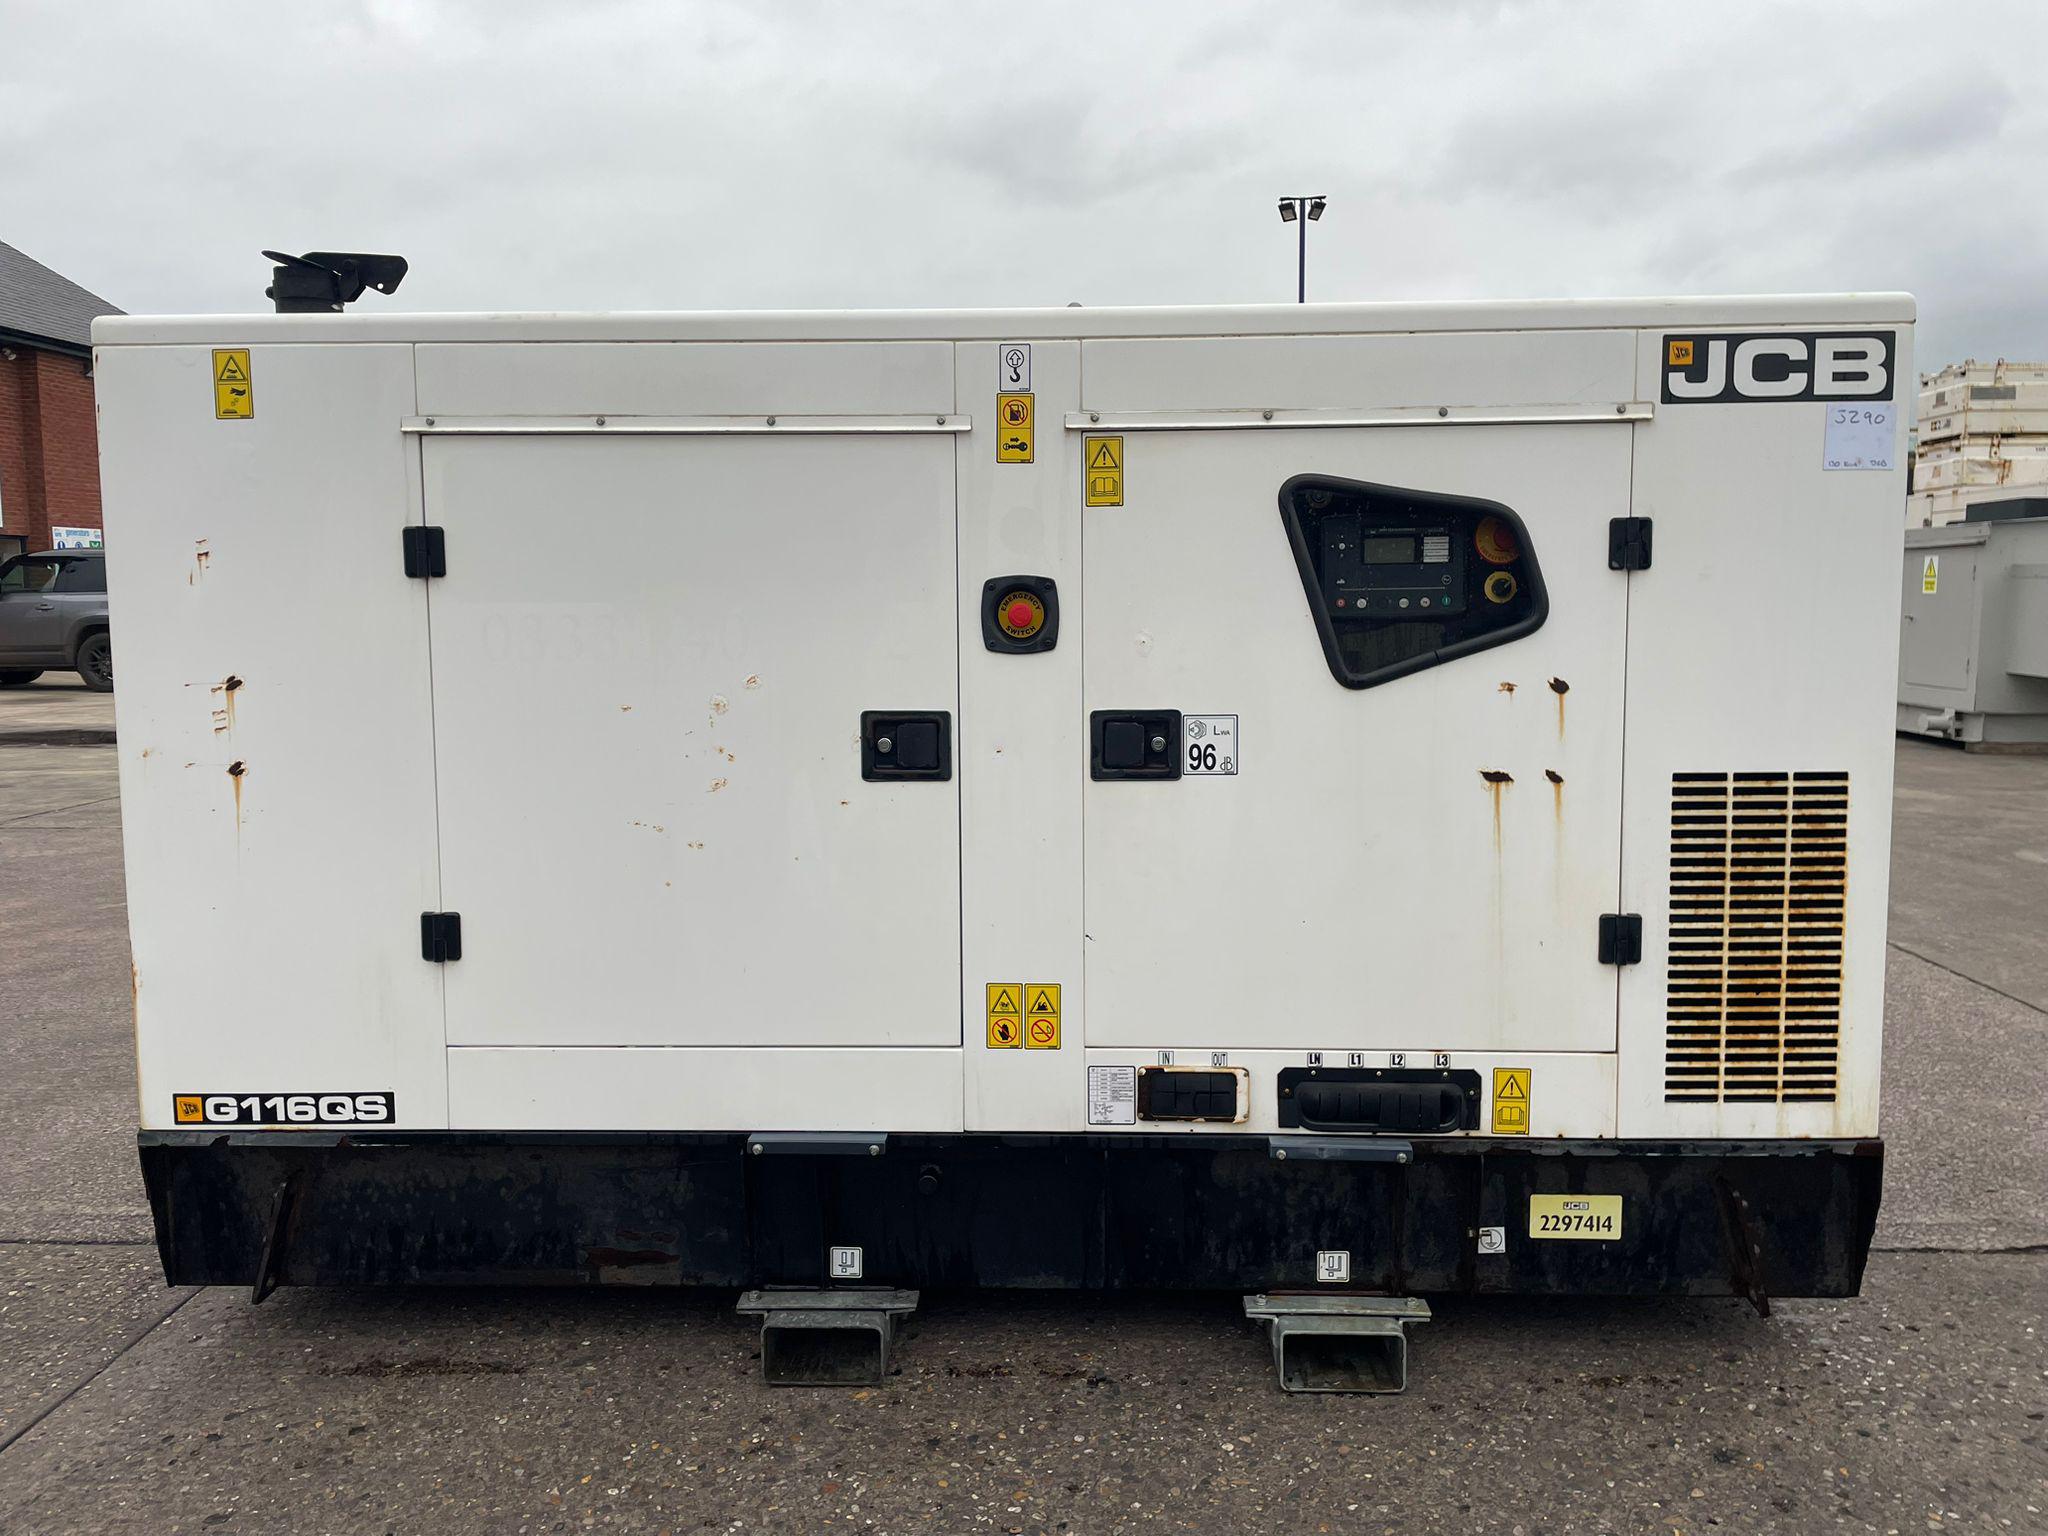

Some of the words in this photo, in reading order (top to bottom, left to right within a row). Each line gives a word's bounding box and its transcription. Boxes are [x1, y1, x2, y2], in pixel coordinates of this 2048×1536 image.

[1668, 338, 1888, 398] JCB
[1001, 593, 1041, 611] EMERGENCY
[1005, 625, 1036, 635] SWITCH
[1188, 743, 1217, 771] 96
[1219, 756, 1233, 771] dB
[1162, 1052, 1171, 1065] IN
[1213, 1053, 1226, 1066] OUT
[1309, 1053, 1321, 1065] LN
[1350, 1054, 1362, 1066] L1
[1392, 1055, 1404, 1066] L2
[1436, 1055, 1449, 1066] L3
[181, 1101, 200, 1116] JCB
[205, 1095, 388, 1122] G116QS
[1563, 1202, 1589, 1210] JCB
[1540, 1214, 1613, 1232] 2297414
